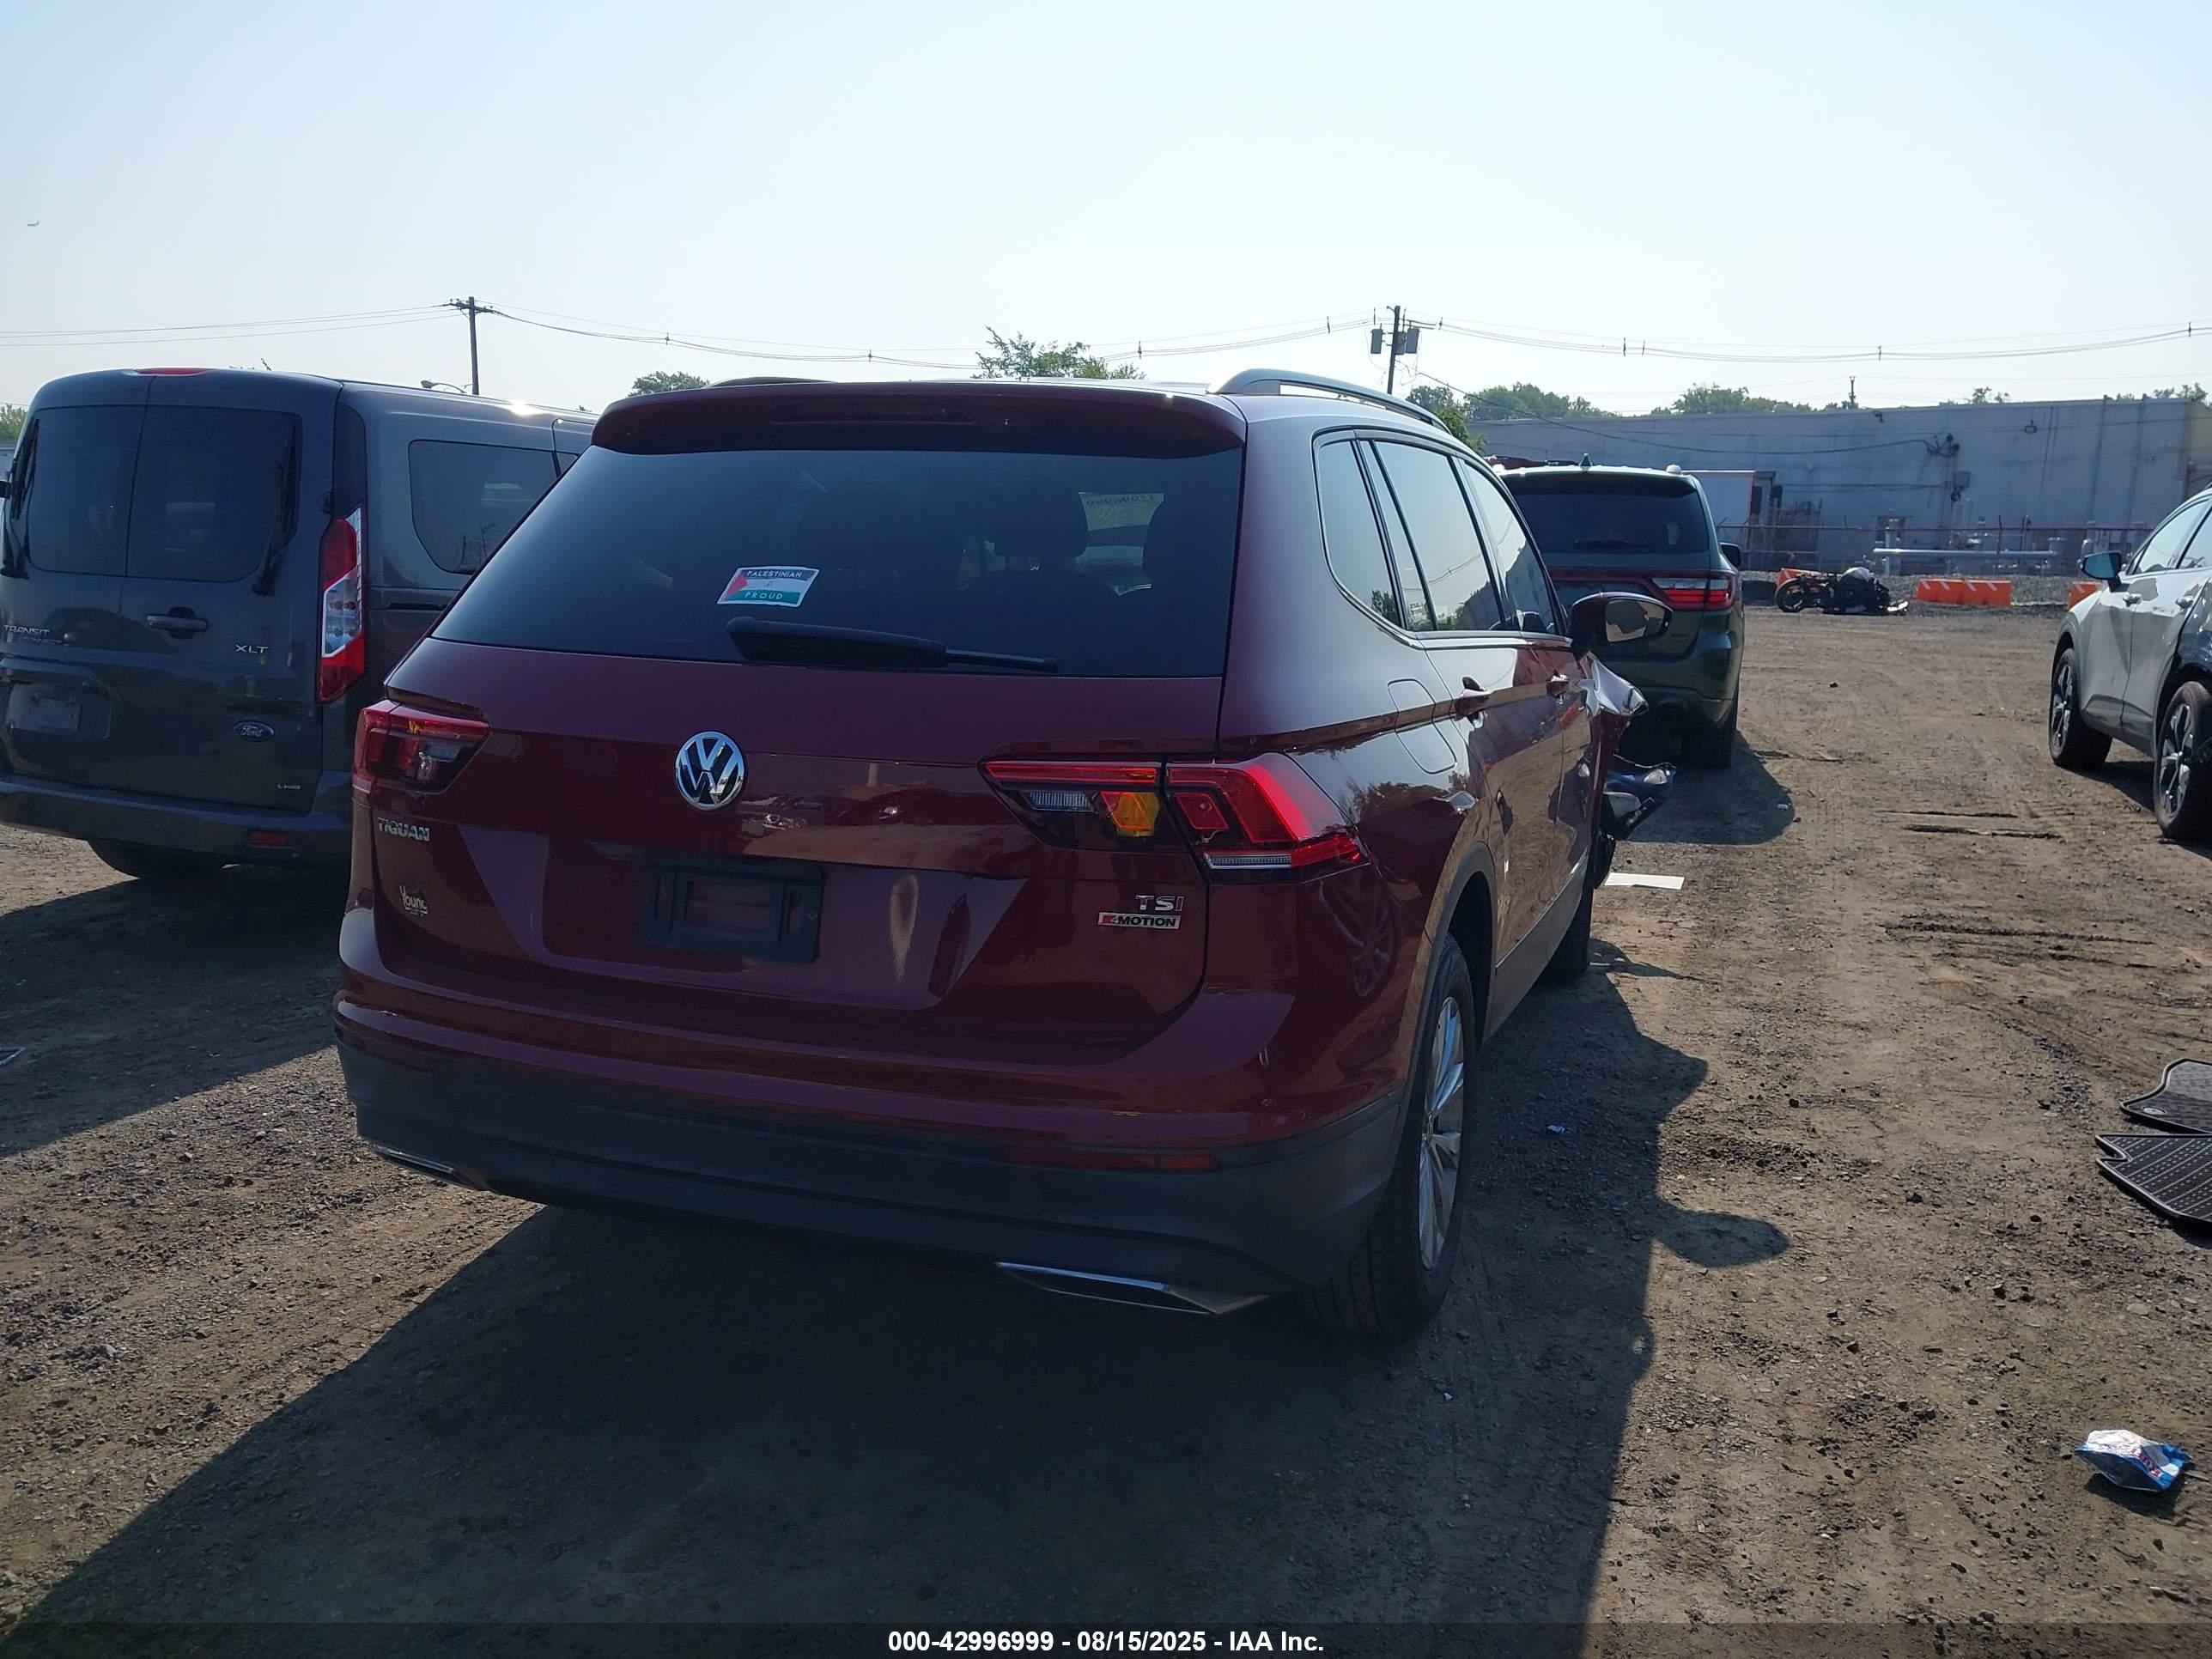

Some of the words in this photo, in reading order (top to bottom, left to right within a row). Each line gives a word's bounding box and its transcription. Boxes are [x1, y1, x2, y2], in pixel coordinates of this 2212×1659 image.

[746, 570, 803, 579] PALESTINIAN
[744, 592, 783, 600] PROUD
[235, 644, 269, 653] XLT
[378, 817, 430, 842] TIGUAN
[1135, 895, 1184, 912] TSI
